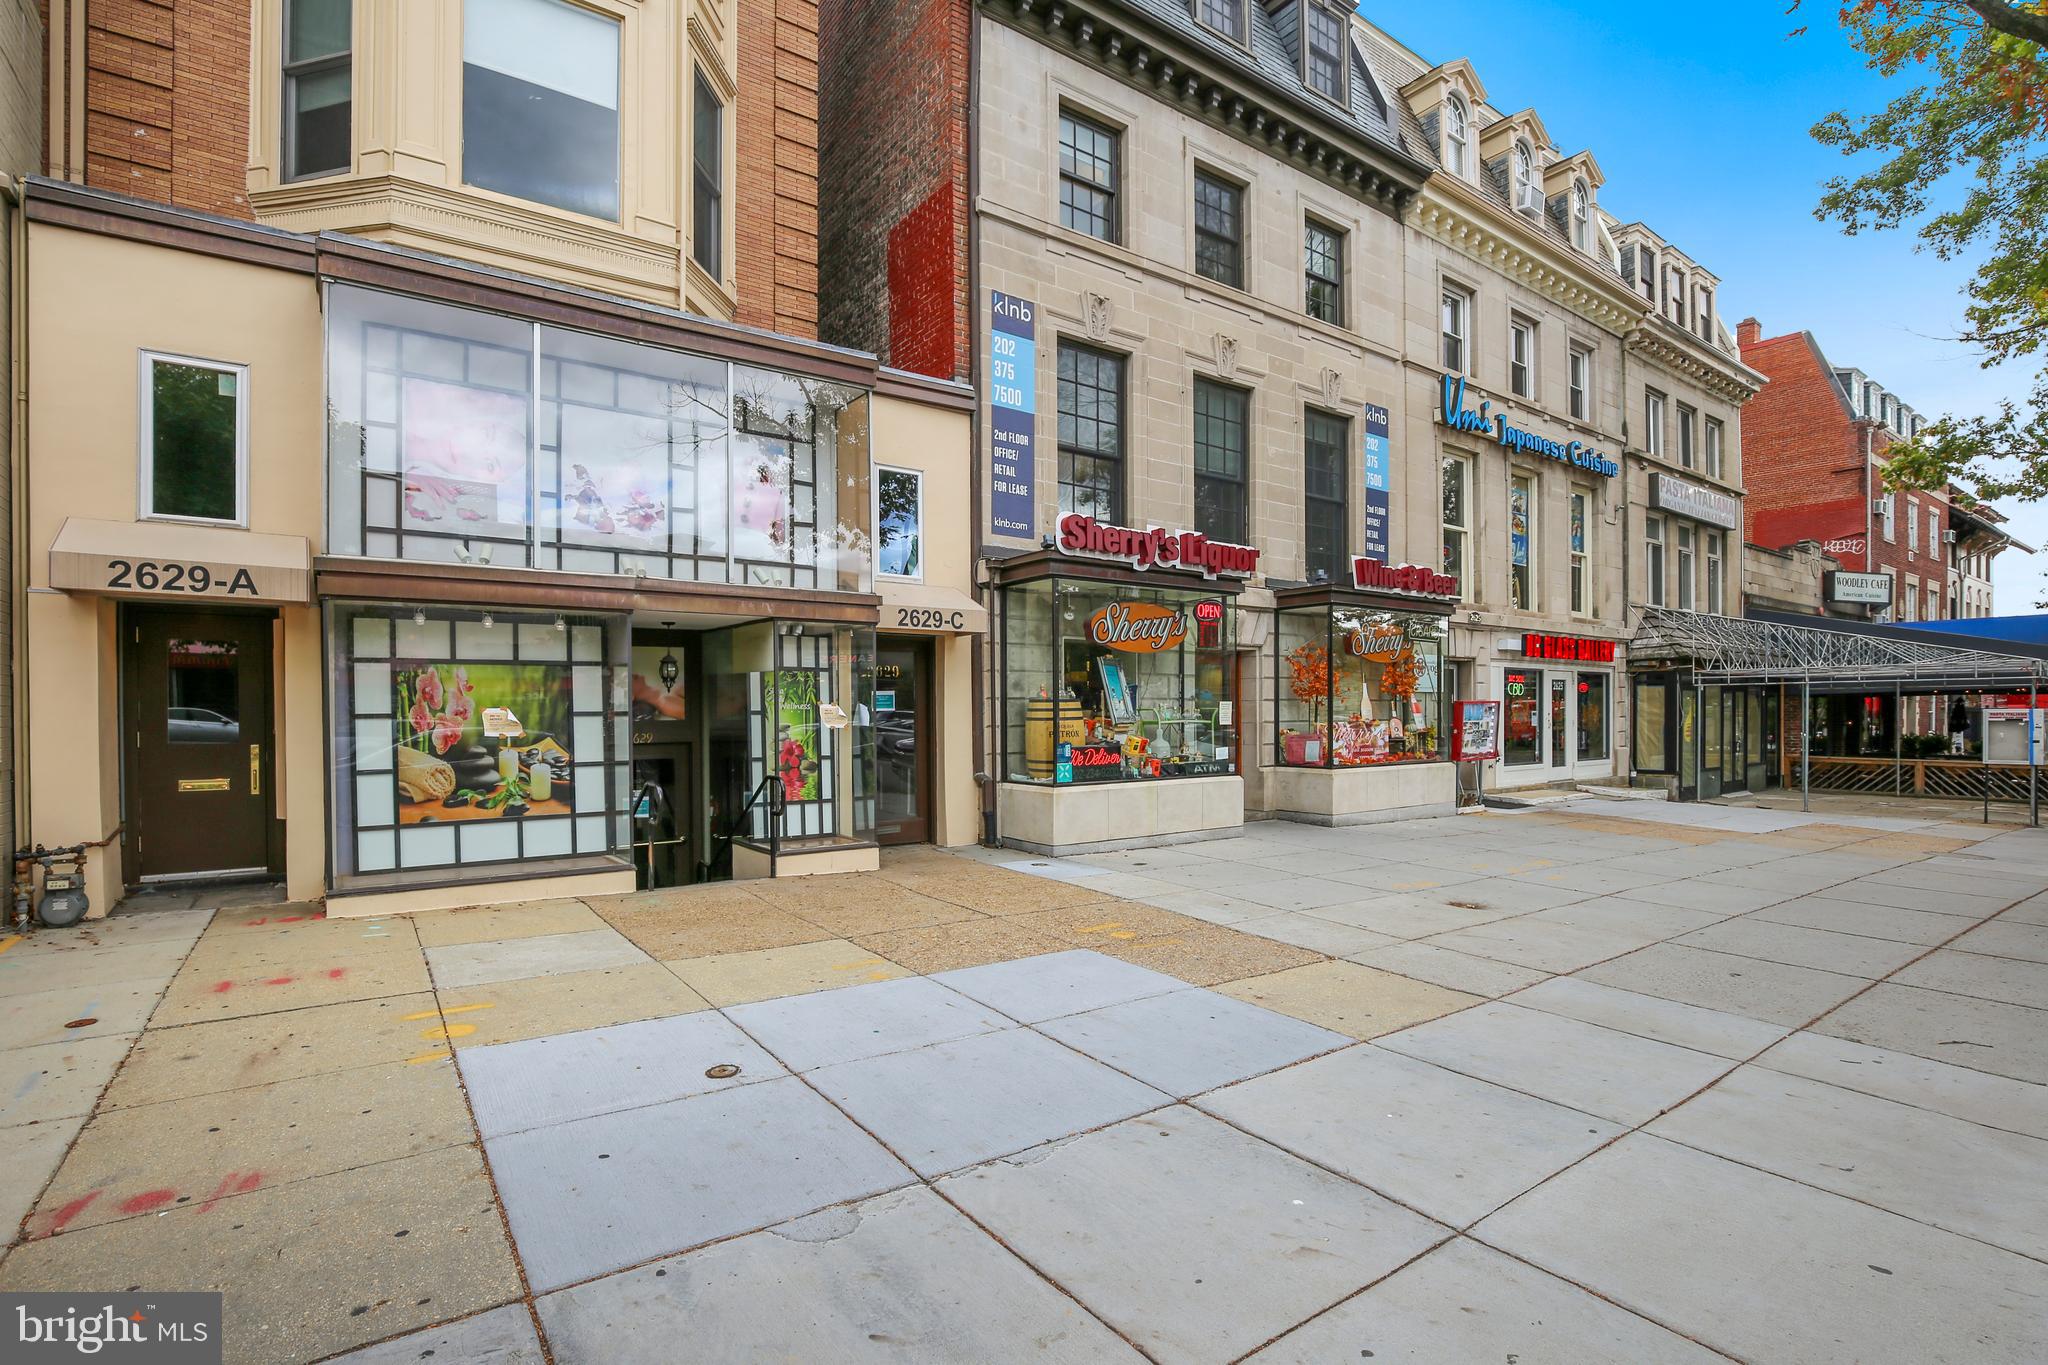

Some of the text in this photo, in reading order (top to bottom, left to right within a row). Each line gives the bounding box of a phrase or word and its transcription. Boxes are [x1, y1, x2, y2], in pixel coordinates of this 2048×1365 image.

[994, 292, 1032, 322] klnb
[994, 336, 1015, 357] 202
[994, 359, 1015, 380] 375
[994, 384, 1022, 406] 7500
[1440, 373, 1493, 433] Umi
[1366, 406, 1387, 425] klnb
[994, 429, 1029, 446] 2nd FLOOR
[1366, 437, 1379, 451] 202
[994, 446, 1019, 461] OFFICE/
[1495, 414, 1619, 478] Japanese Cuisine
[1366, 454, 1378, 469] 375
[994, 463, 1016, 478] RETAIL
[1366, 472, 1382, 487] 7500
[994, 482, 1028, 497] FOR LEASE
[1660, 476, 1734, 514] PASTA ITALIANA
[1366, 504, 1374, 513] 2nd
[994, 516, 1028, 531] klnb.com
[1366, 529, 1379, 540] RETAIL
[1061, 513, 1260, 574] Sherry's Liquor
[1366, 542, 1386, 553] FOR LEASE
[107, 560, 259, 595] 2629-A
[1355, 558, 1458, 596] Wine & Beer
[1836, 576, 1888, 590] WOODLEY CAFE
[1842, 591, 1863, 599] American
[1197, 604, 1220, 618] OPEN
[897, 608, 964, 630] 2629-C
[1092, 602, 1189, 648] Sherry's
[1544, 635, 1576, 660] GLASS
[1578, 638, 1616, 662] GALLERY
[1507, 683, 1525, 696] CBD
[780, 702, 811, 710] Wellness
[1048, 730, 1080, 739] PTRÓN
[1071, 749, 1084, 766] We
[1085, 748, 1121, 766] Deliver
[1194, 763, 1220, 773] ATM
